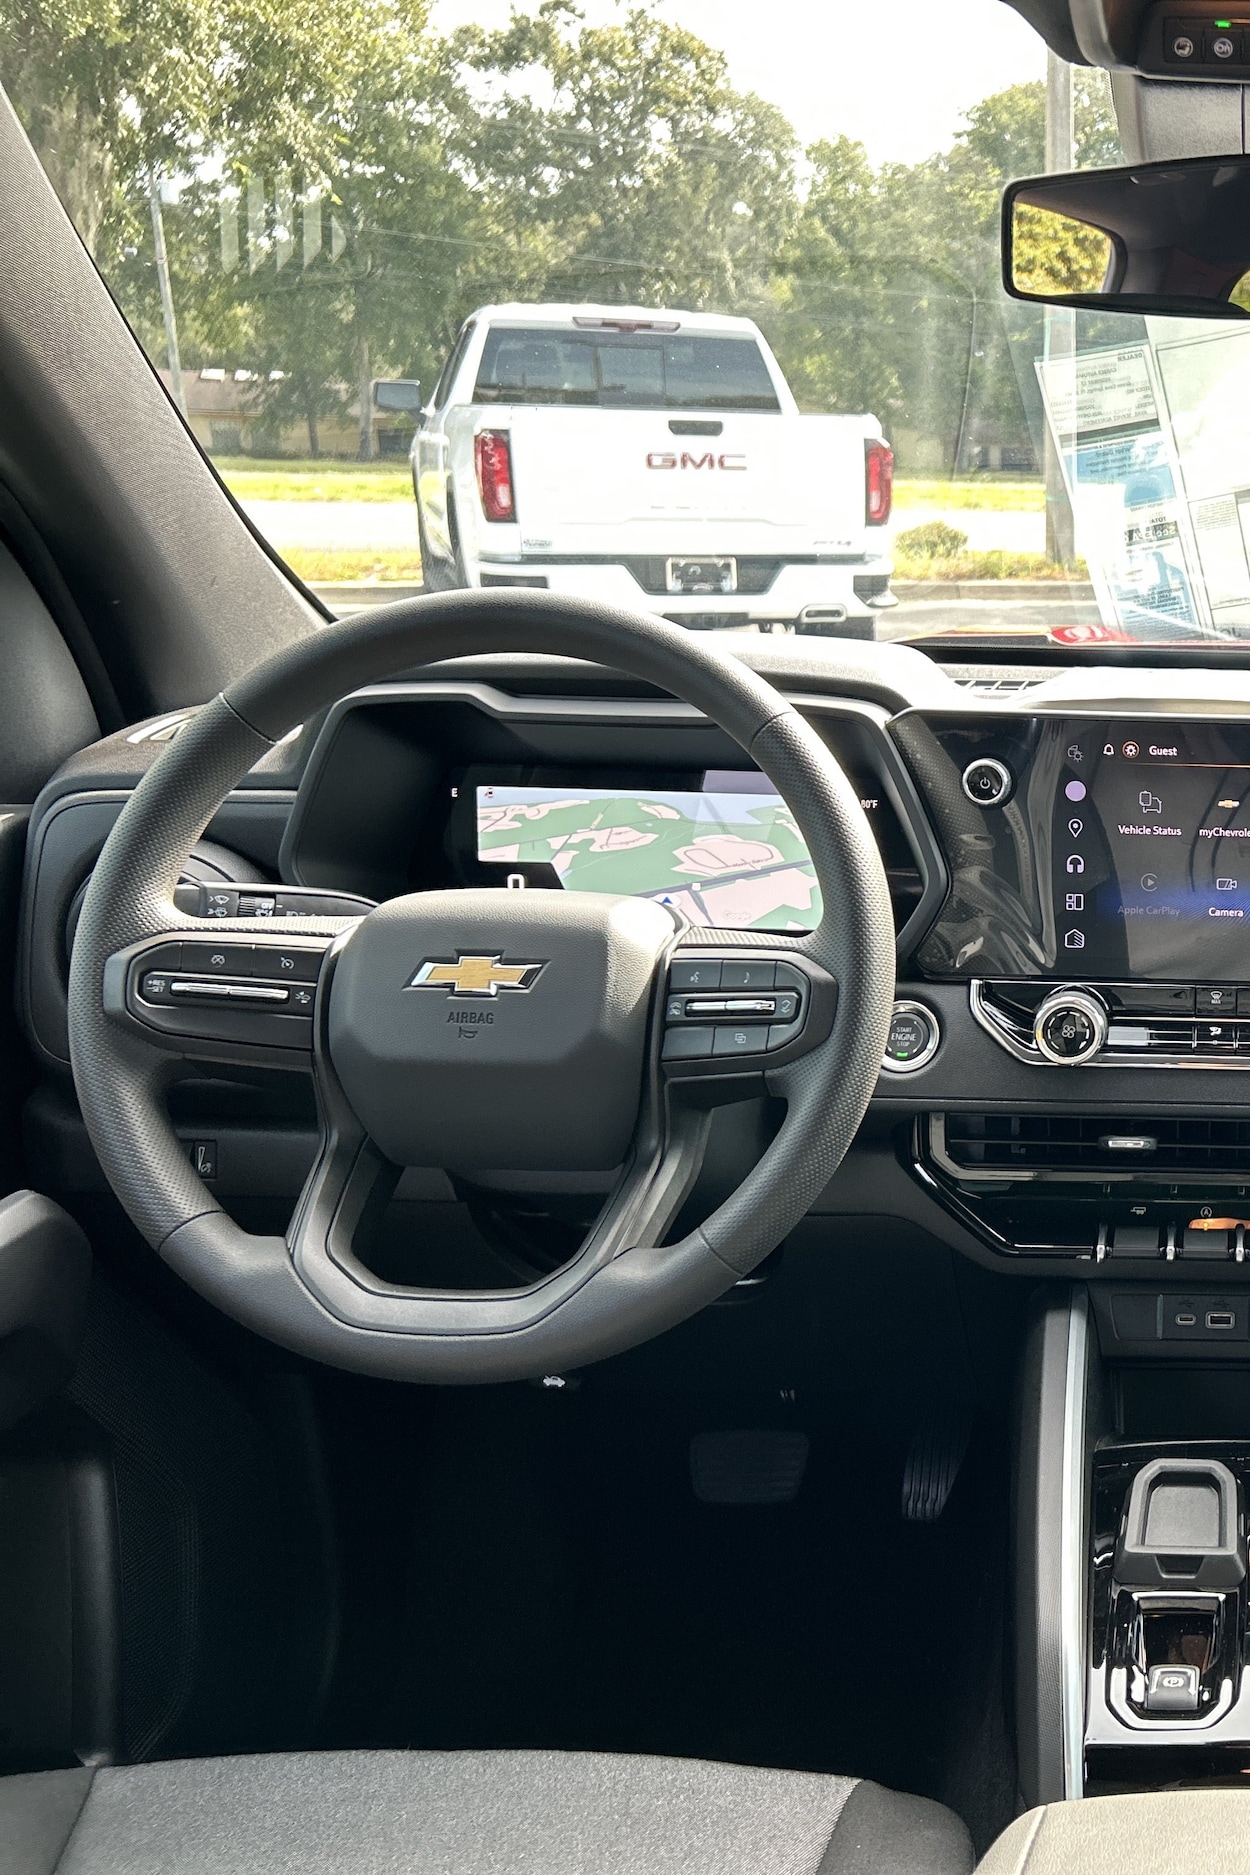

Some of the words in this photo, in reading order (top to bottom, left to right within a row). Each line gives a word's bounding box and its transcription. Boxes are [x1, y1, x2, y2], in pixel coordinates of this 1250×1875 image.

[646, 452, 748, 470] GMC
[1149, 745, 1178, 756] Guest
[1118, 825, 1152, 835] Vehicle
[1152, 826, 1182, 836] Status
[1117, 905, 1145, 916] Apple
[1146, 905, 1180, 917] CarPlay
[1208, 907, 1244, 917] Camera
[447, 1011, 494, 1024] AIRBAG
[891, 1033, 916, 1041] ENGINE
